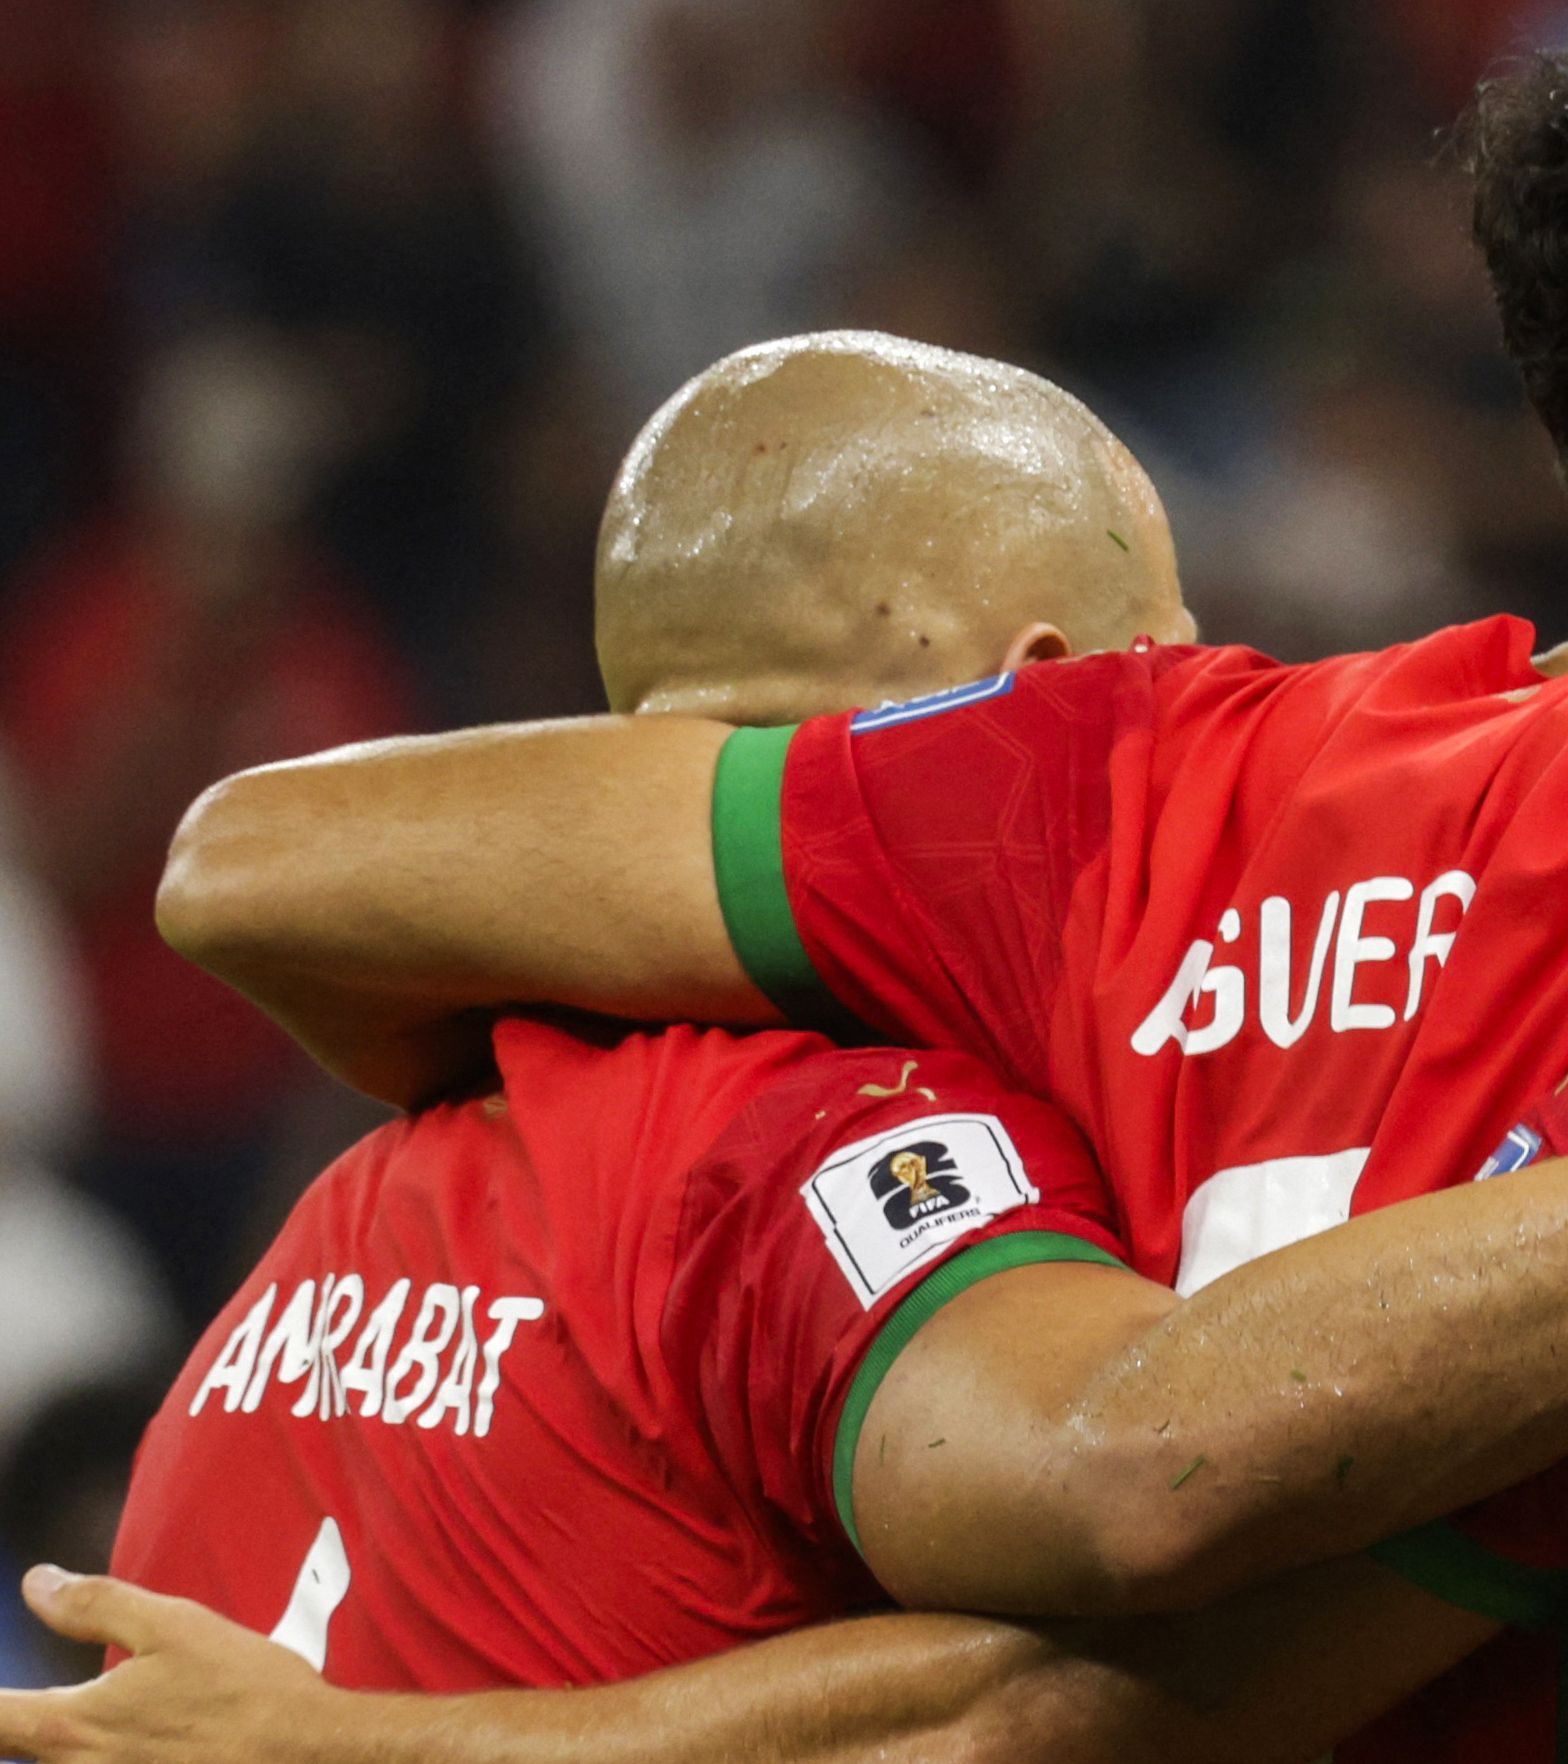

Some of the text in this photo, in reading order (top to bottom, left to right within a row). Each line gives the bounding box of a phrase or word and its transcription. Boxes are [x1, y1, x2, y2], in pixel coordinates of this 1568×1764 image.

[908, 1194, 951, 1219] FIFA
[899, 1207, 981, 1249] QUALIFIERS
[188, 1272, 545, 1438] AMRABAT
